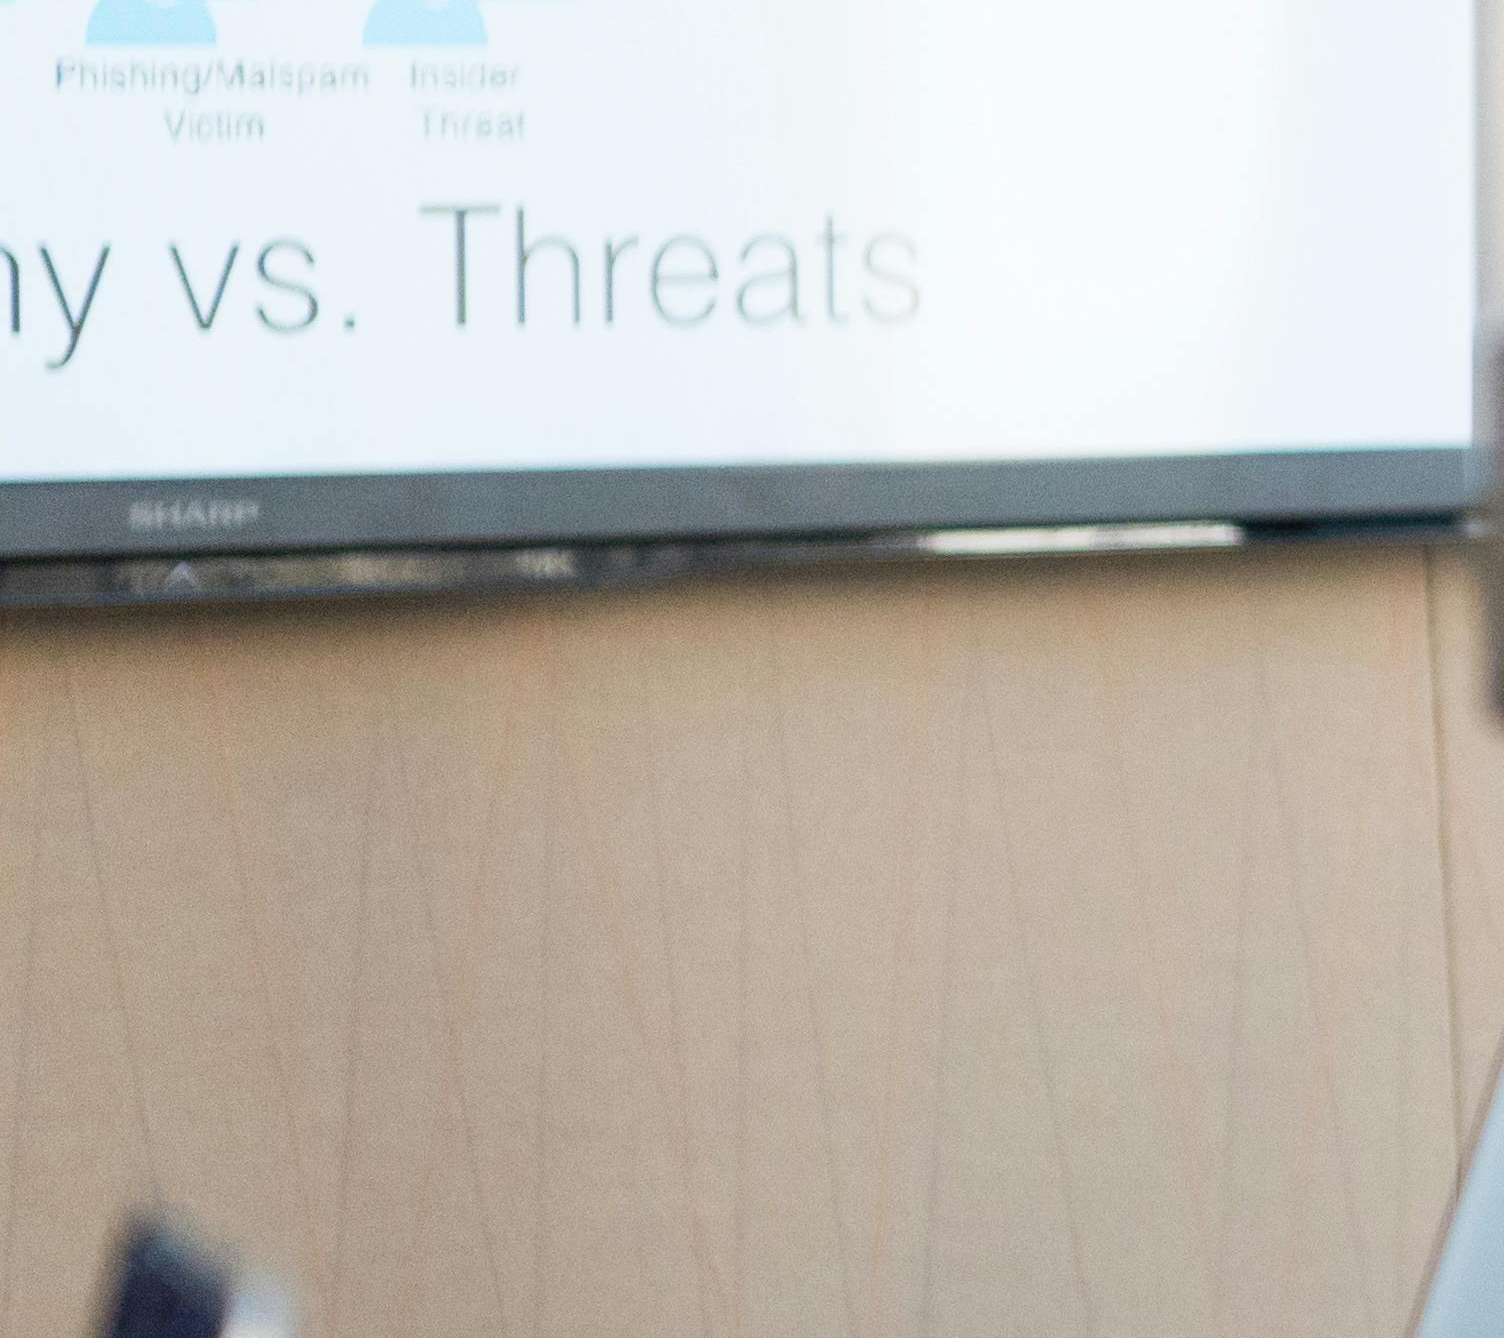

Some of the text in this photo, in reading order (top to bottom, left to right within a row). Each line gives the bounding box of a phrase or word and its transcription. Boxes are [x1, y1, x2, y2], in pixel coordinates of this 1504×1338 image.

[53, 56, 371, 97] Phishing/Malspam
[409, 59, 521, 92] Insider
[162, 109, 266, 144] Victim
[420, 108, 528, 144] Threat
[167, 234, 359, 335] vs.
[418, 201, 924, 330] Threats
[129, 499, 261, 533] SHARP
